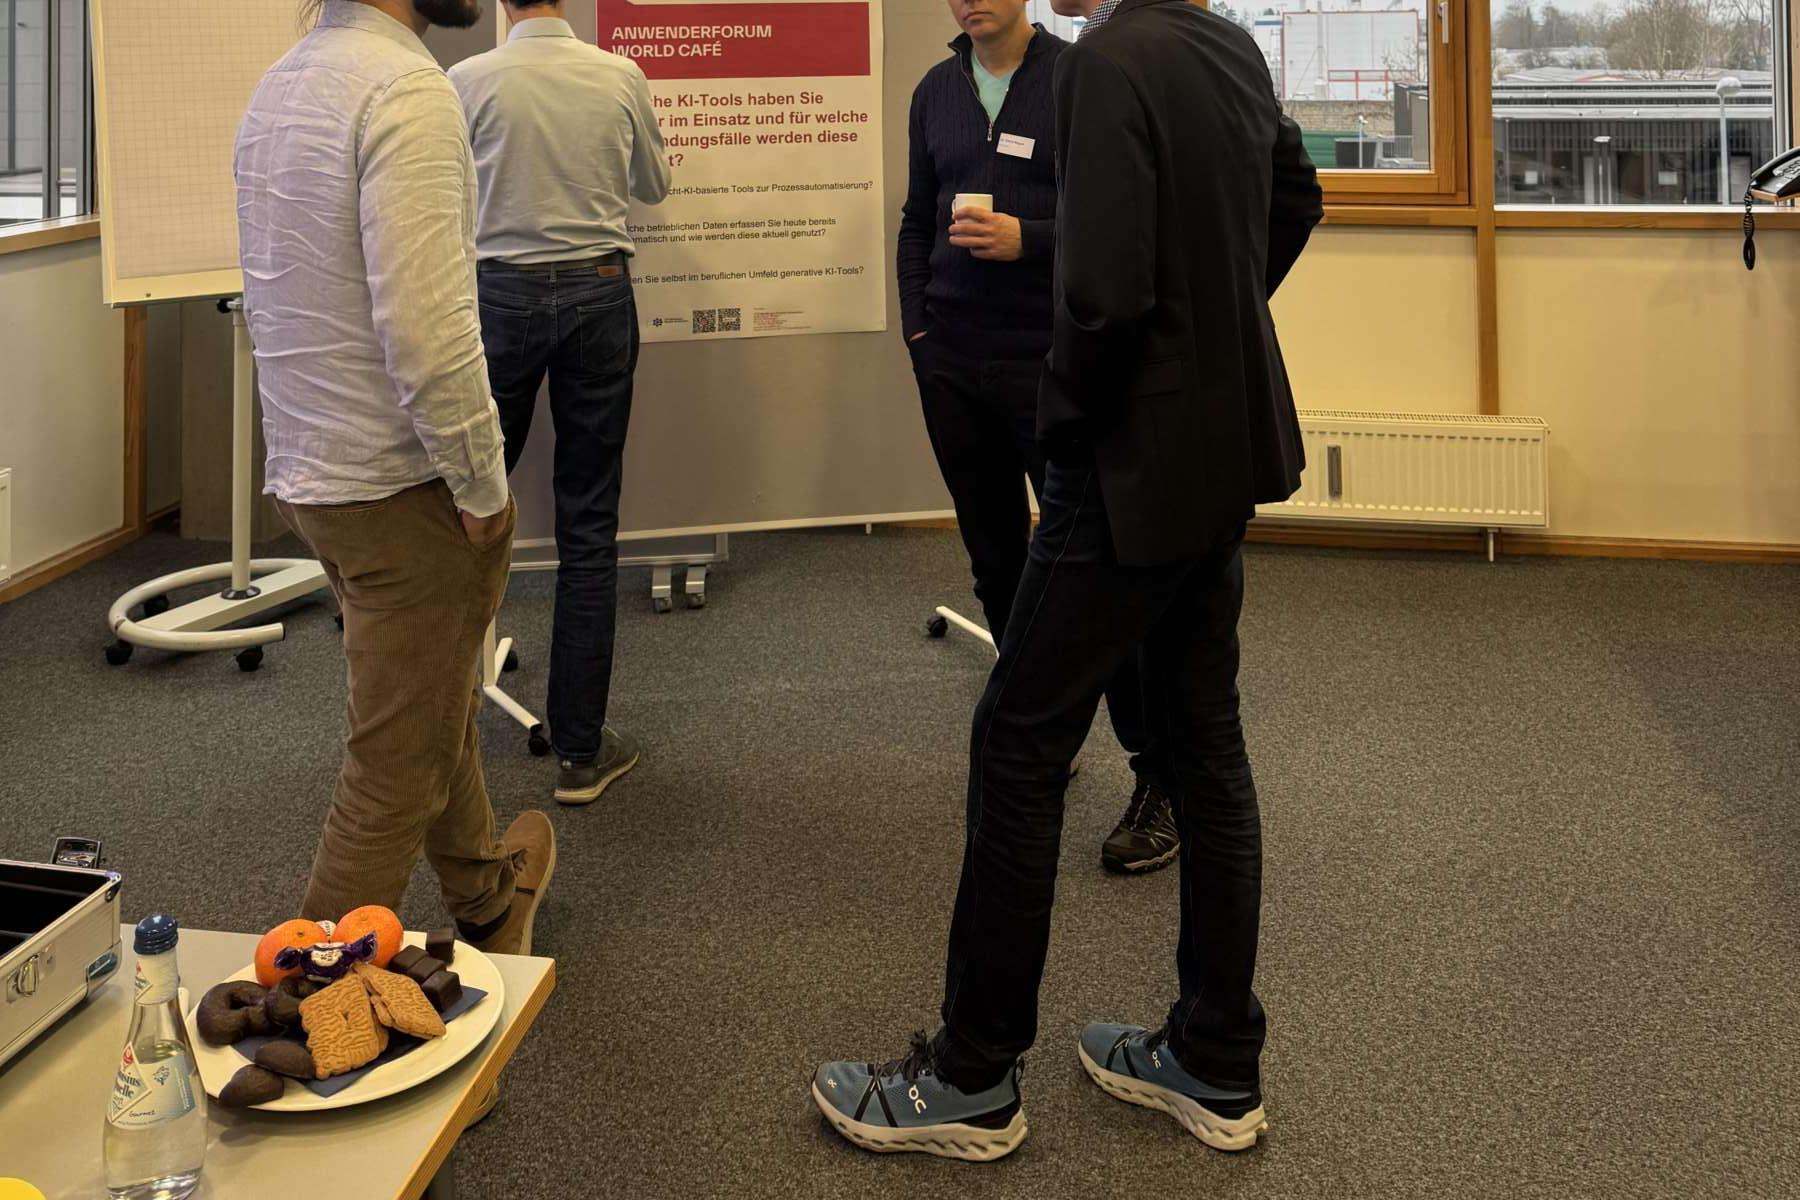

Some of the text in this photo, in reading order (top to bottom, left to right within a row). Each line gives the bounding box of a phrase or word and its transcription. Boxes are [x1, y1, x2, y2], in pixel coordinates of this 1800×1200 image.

[612, 25, 772, 40] ANWENDERFORUM
[612, 41, 722, 58] WORLD CAFÉ
[678, 94, 743, 107] KI-Tools
[748, 92, 795, 106] haben
[800, 91, 824, 105] Sie
[669, 114, 688, 128] im
[694, 112, 750, 127] Einsatz
[755, 112, 785, 125] und
[789, 110, 811, 124] für
[815, 110, 869, 123] welche
[664, 130, 858, 150] ndungsfälle werden diese
[732, 184, 754, 193] Tools
[756, 185, 769, 193] zur
[772, 181, 873, 192] Prozessautomatisierung?
[646, 222, 700, 232] betrieblichen
[702, 221, 728, 230] Daten
[730, 219, 765, 229] erfassen
[768, 218, 781, 227] Sie
[783, 217, 807, 227] heute
[808, 216, 836, 226] bereits
[670, 233, 686, 243] und
[687, 233, 703, 242] wie
[704, 231, 735, 241] werden
[737, 230, 759, 239] diese
[762, 229, 789, 238] aktuell
[791, 228, 826, 240] genutzt?
[645, 275, 659, 284] Sie
[661, 273, 686, 283] selbst
[688, 273, 699, 281] im
[701, 271, 746, 281] beruflichen
[748, 270, 778, 279] Umfeld
[780, 268, 822, 279] generative
[825, 266, 864, 276] KI-Tools?
